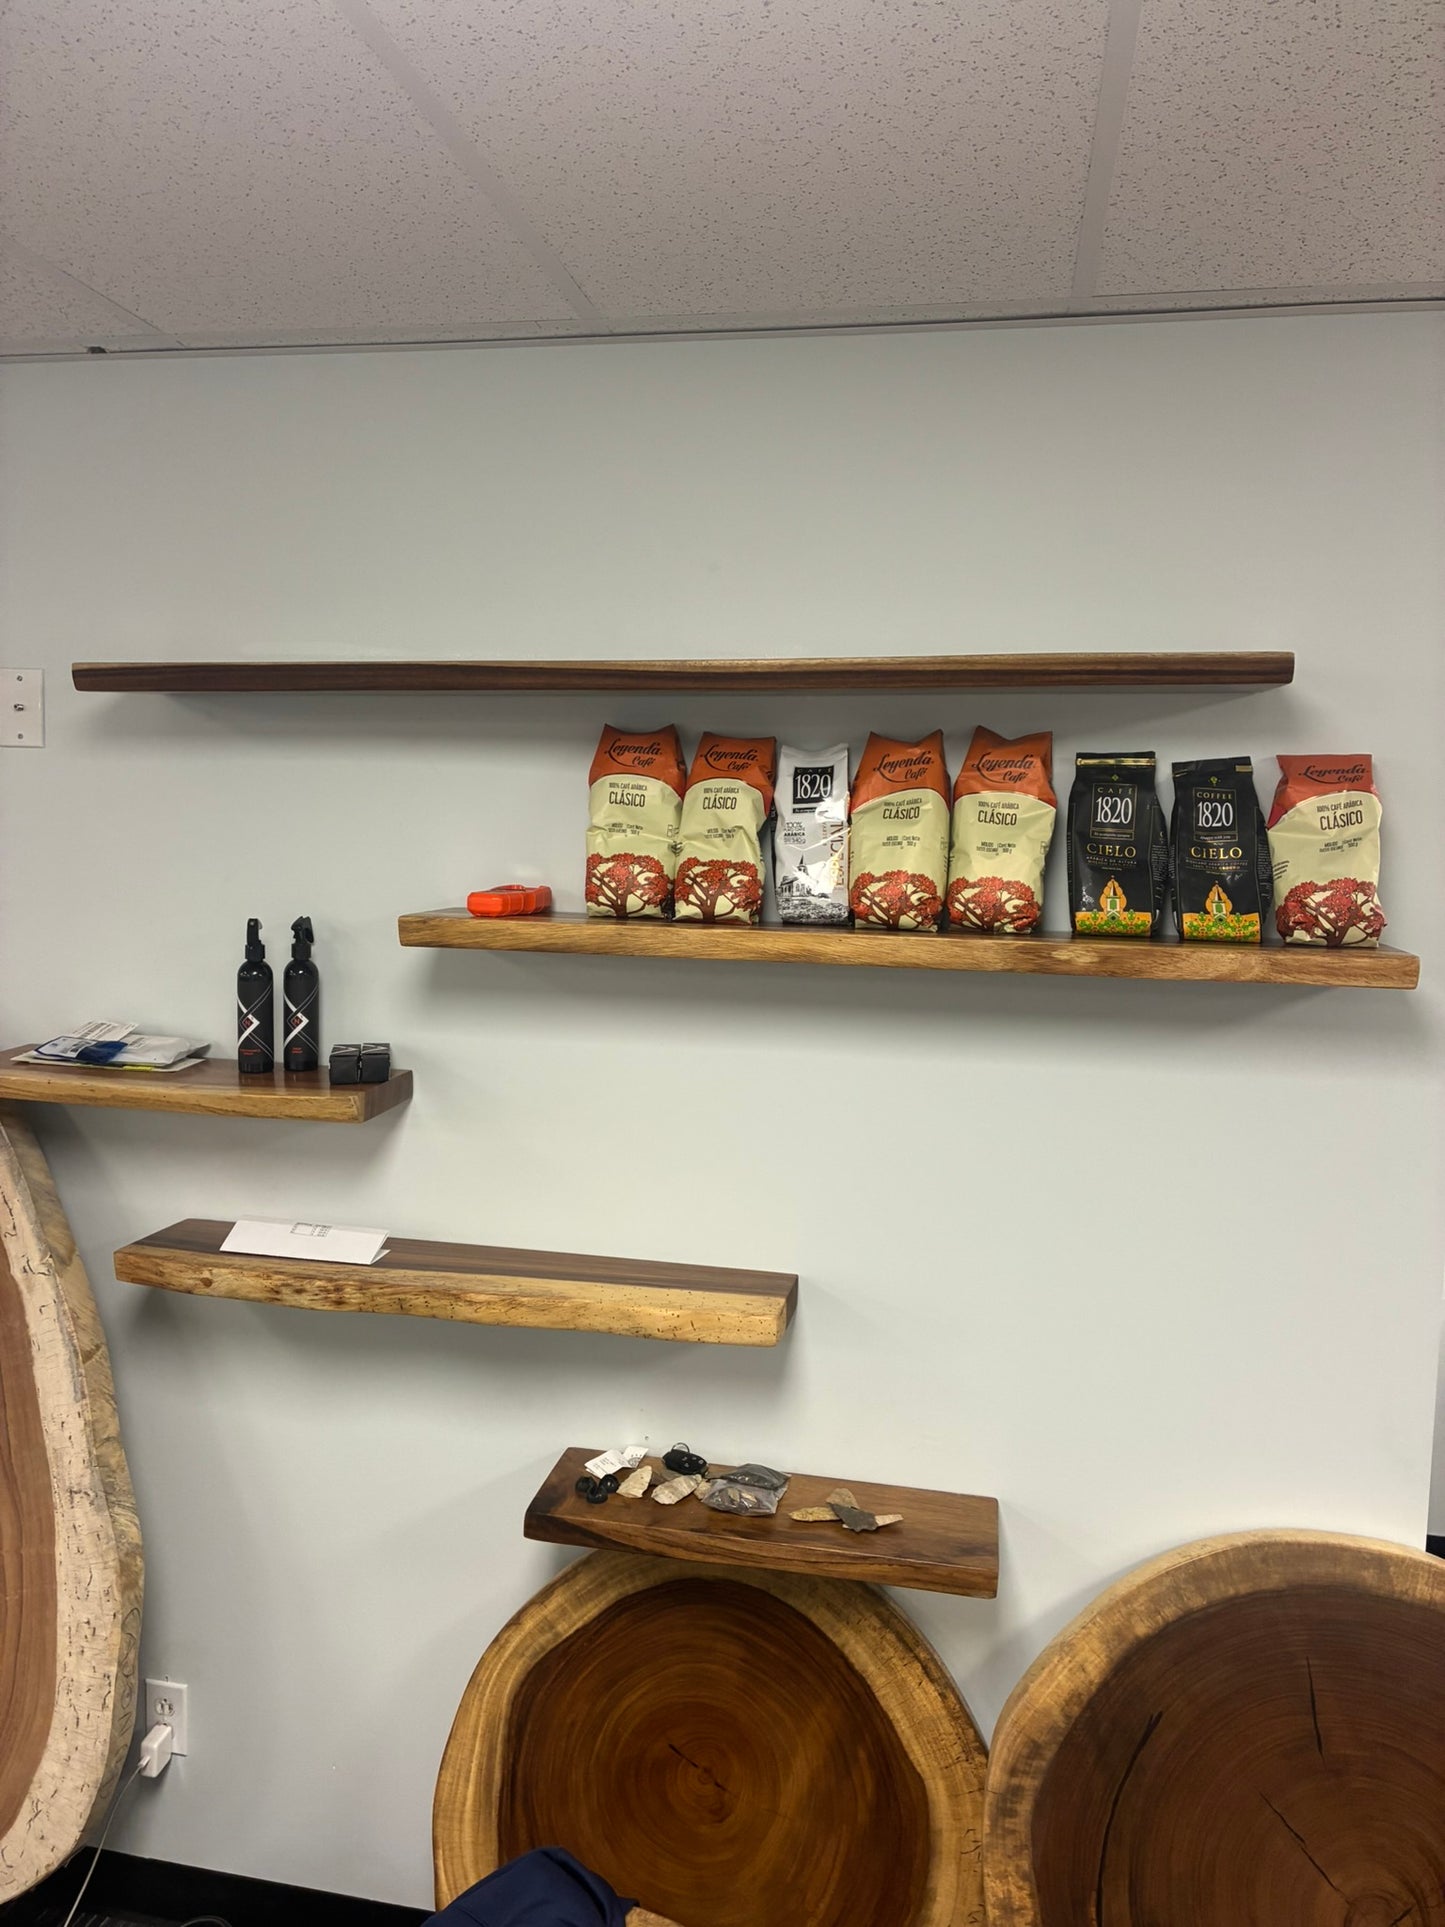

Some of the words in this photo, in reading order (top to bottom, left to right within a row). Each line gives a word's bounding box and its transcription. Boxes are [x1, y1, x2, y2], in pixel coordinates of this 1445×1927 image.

[604, 738, 662, 758] Leyenda
[700, 744, 759, 763] Leyenda
[873, 751, 934, 774] Leyenda
[972, 752, 1035, 773] Leyenda
[1298, 764, 1366, 778] Leyenda
[905, 768, 928, 780] Café
[1002, 771, 1029, 783] Café
[795, 774, 831, 799] 1820
[608, 790, 646, 807] CLÁSICO
[702, 794, 738, 810] CLÁSICO
[1196, 792, 1233, 800] COFFEE
[882, 806, 920, 820] CLÁSICO
[977, 809, 1018, 826] CLÁSICO
[1096, 796, 1133, 824] 1820
[1197, 801, 1234, 828] 1820
[1320, 811, 1364, 831] CLÁSICO
[1086, 843, 1137, 858] CIELO
[1191, 846, 1243, 860] CIELO
